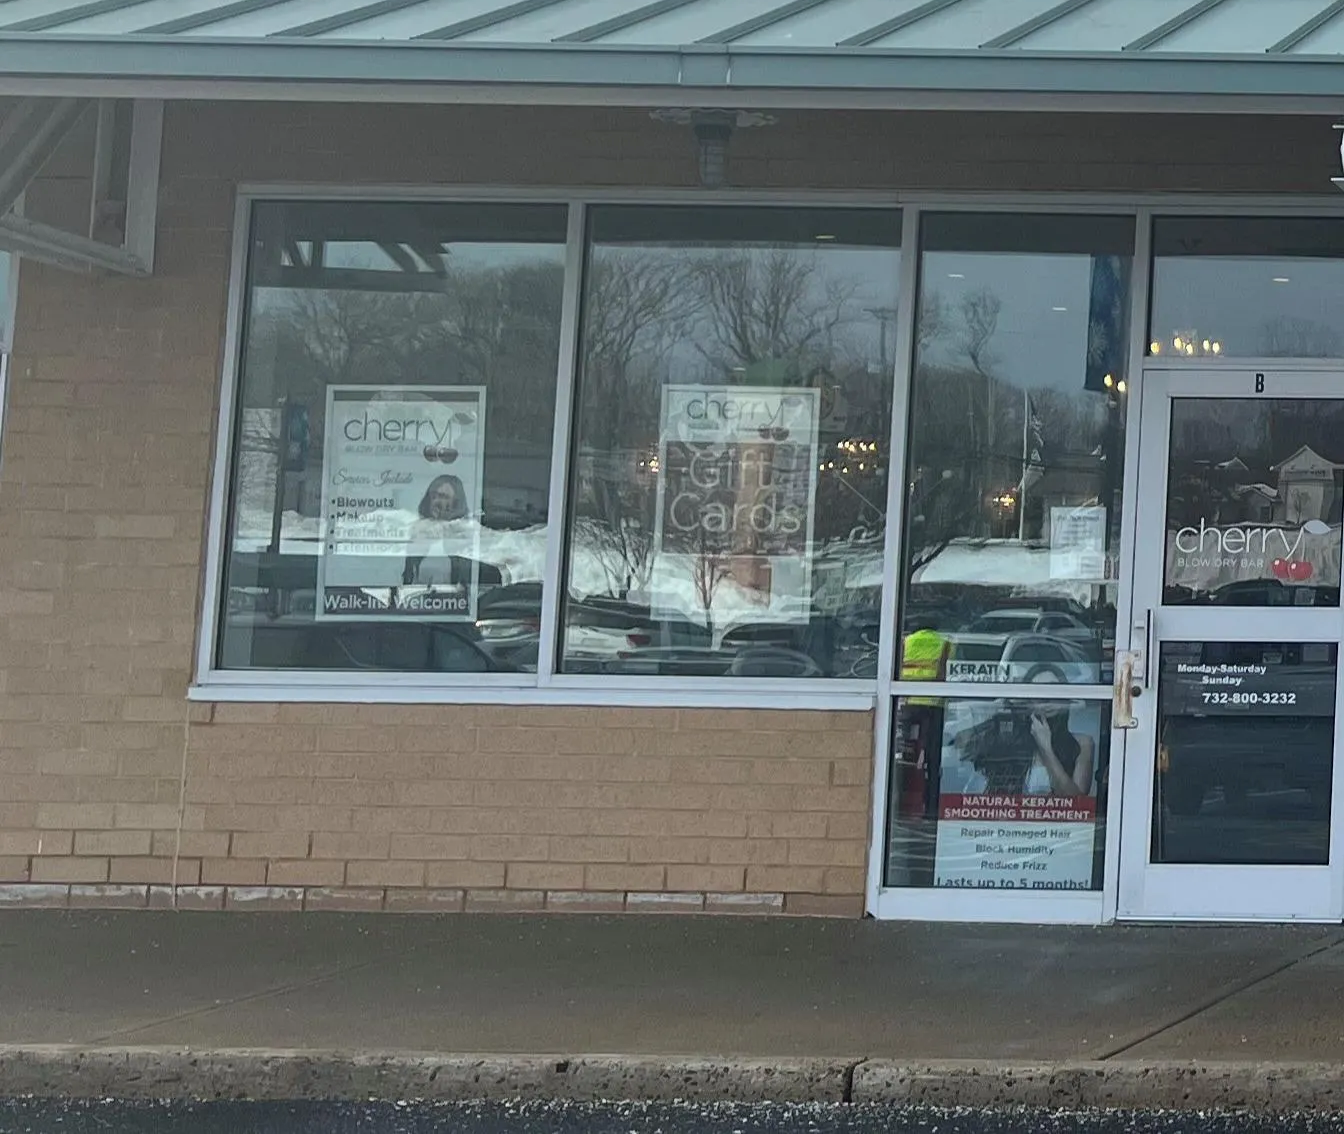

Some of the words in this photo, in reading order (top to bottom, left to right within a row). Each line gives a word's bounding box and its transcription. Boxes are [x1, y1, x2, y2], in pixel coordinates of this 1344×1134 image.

[1255, 373, 1265, 394] B
[687, 392, 783, 426] cherry
[344, 411, 451, 446] cherry
[690, 449, 772, 488] Gift
[671, 492, 801, 533] Cards
[1175, 517, 1304, 560] cherry
[1178, 558, 1212, 567] BLOW
[1213, 558, 1237, 567] DRY
[1241, 559, 1264, 567] BAR
[324, 595, 389, 609] Walk-Ins
[949, 663, 1010, 676] KERATIN
[1177, 664, 1267, 674] Monday-Saturday
[1202, 692, 1296, 704] 732-800-3232
[963, 796, 1018, 807] NATURAL
[1022, 797, 1073, 807] KERATIN
[944, 808, 1016, 819] SMOOTHING
[1021, 809, 1090, 820] TREATMENT
[961, 828, 993, 839] Repair
[997, 828, 1047, 840] Damaged
[1008, 845, 1054, 856] Humidity
[981, 860, 1019, 870] Reduce
[1023, 861, 1048, 870] Frizz
[1001, 878, 1015, 888] to
[1020, 878, 1027, 888] 5
